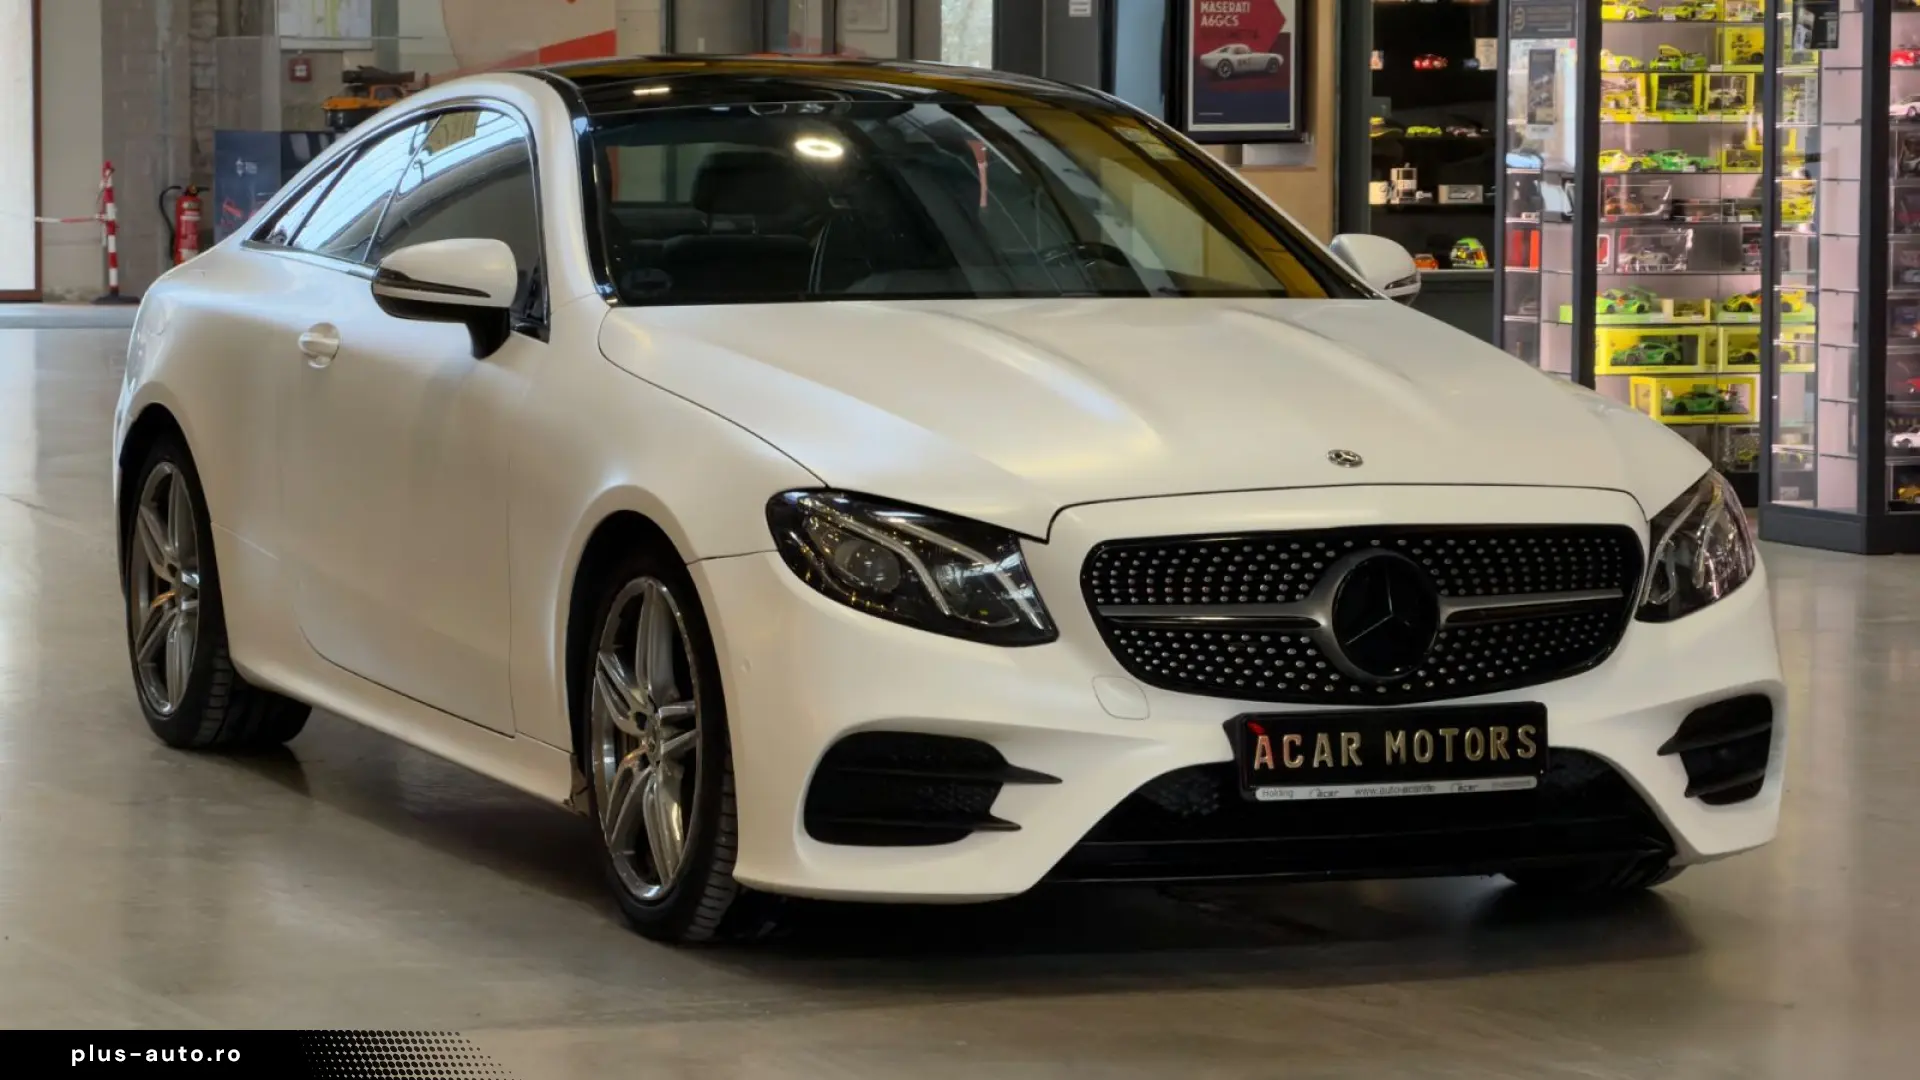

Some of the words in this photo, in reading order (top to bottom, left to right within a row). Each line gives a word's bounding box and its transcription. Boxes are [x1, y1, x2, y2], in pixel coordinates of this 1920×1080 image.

[1200, 1, 1251, 13] MASERATI
[1200, 14, 1240, 27] A6GCS
[1254, 732, 1363, 770] ACAR
[1385, 725, 1537, 765] MOTORS
